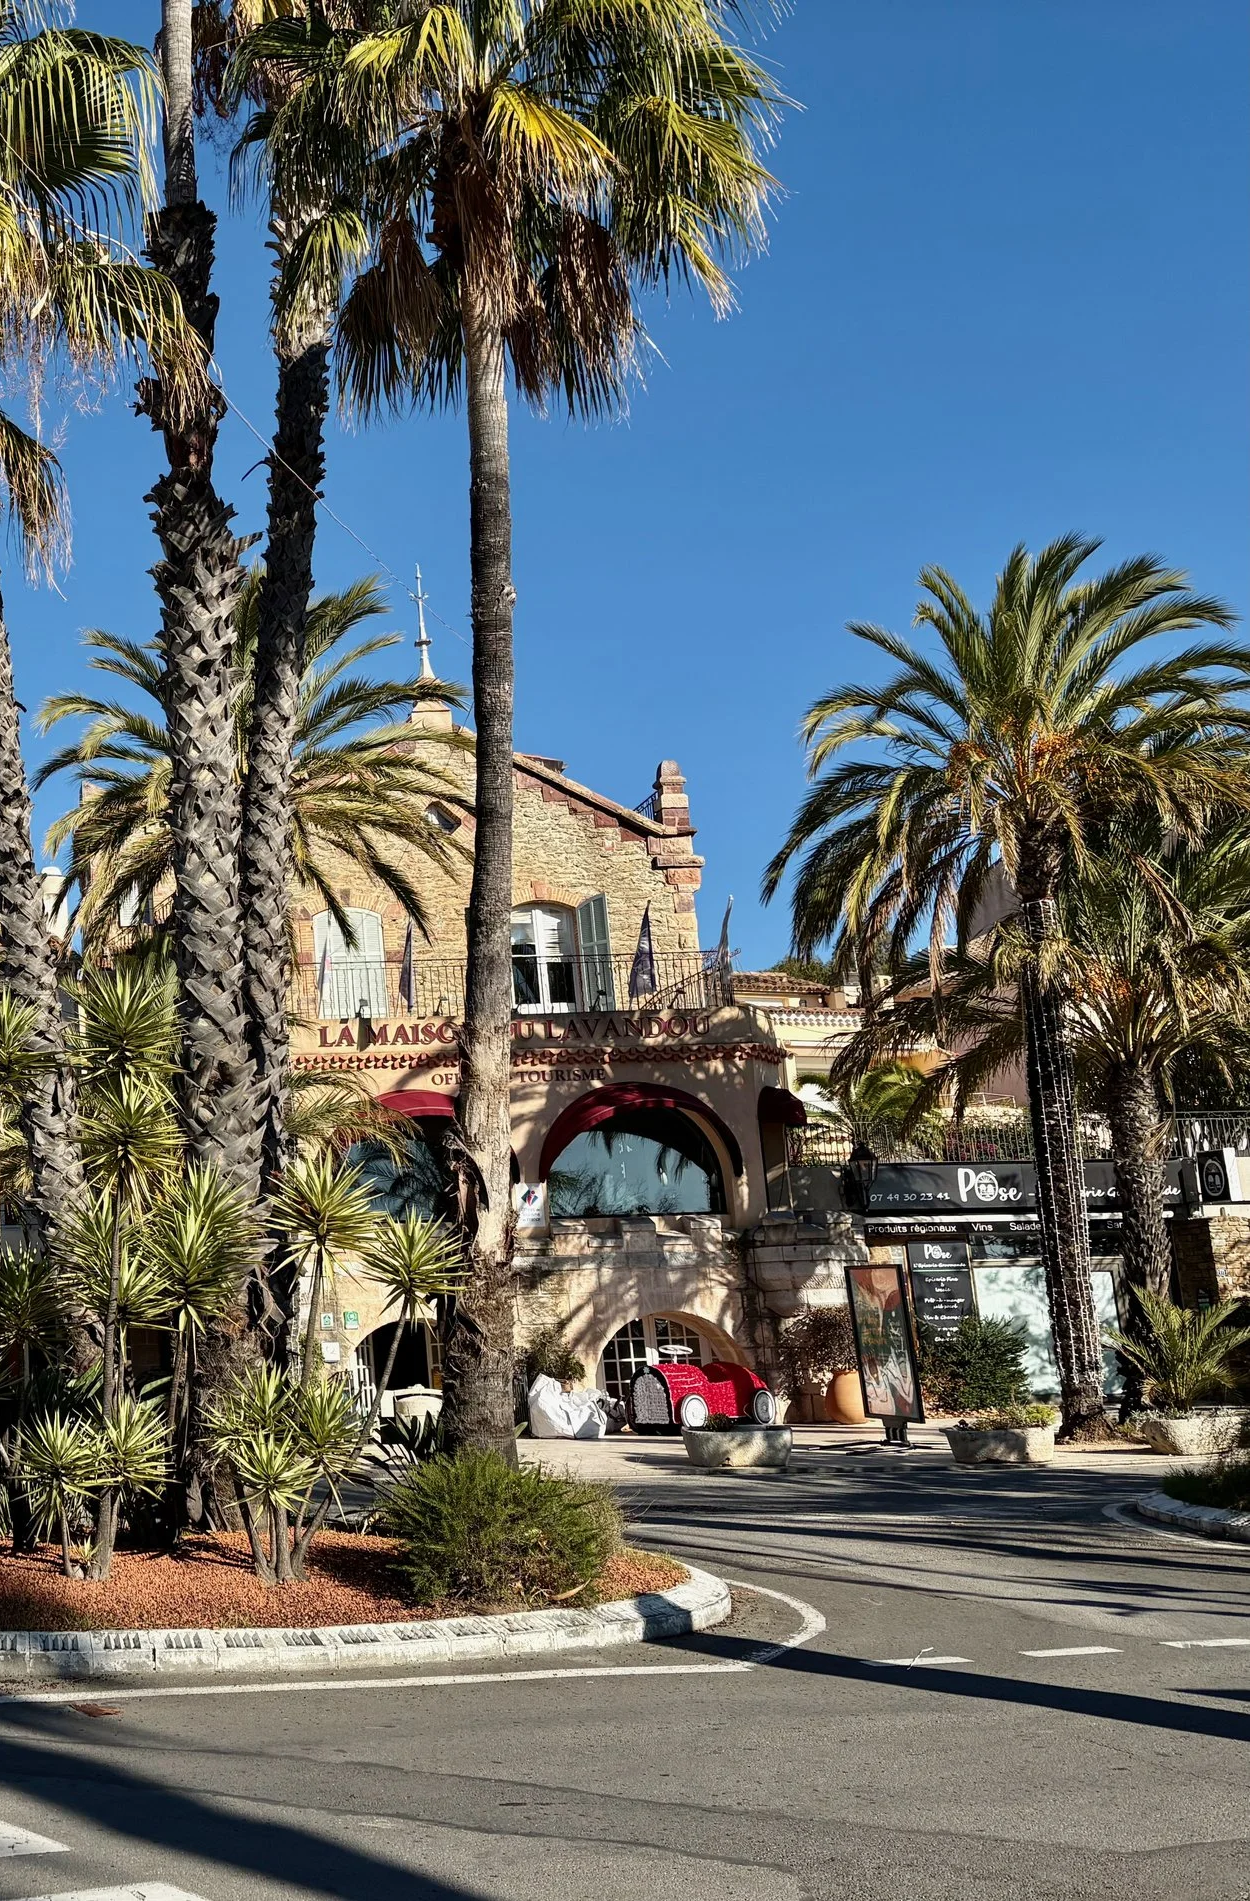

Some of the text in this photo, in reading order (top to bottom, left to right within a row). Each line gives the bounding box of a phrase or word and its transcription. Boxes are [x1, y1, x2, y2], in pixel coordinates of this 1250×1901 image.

[318, 1025, 357, 1048] LA
[365, 1022, 458, 1046] MAISO
[544, 1015, 710, 1040] LAVANDOU
[516, 1068, 606, 1083] TOURISME
[870, 1193, 883, 1202] 07
[887, 1193, 900, 1202] 49
[903, 1193, 917, 1201] 30
[920, 1193, 933, 1201] 23
[936, 1192, 950, 1200] 41
[868, 1224, 907, 1233] Produits
[910, 1224, 957, 1234] régionaux
[972, 1223, 993, 1232] Vins
